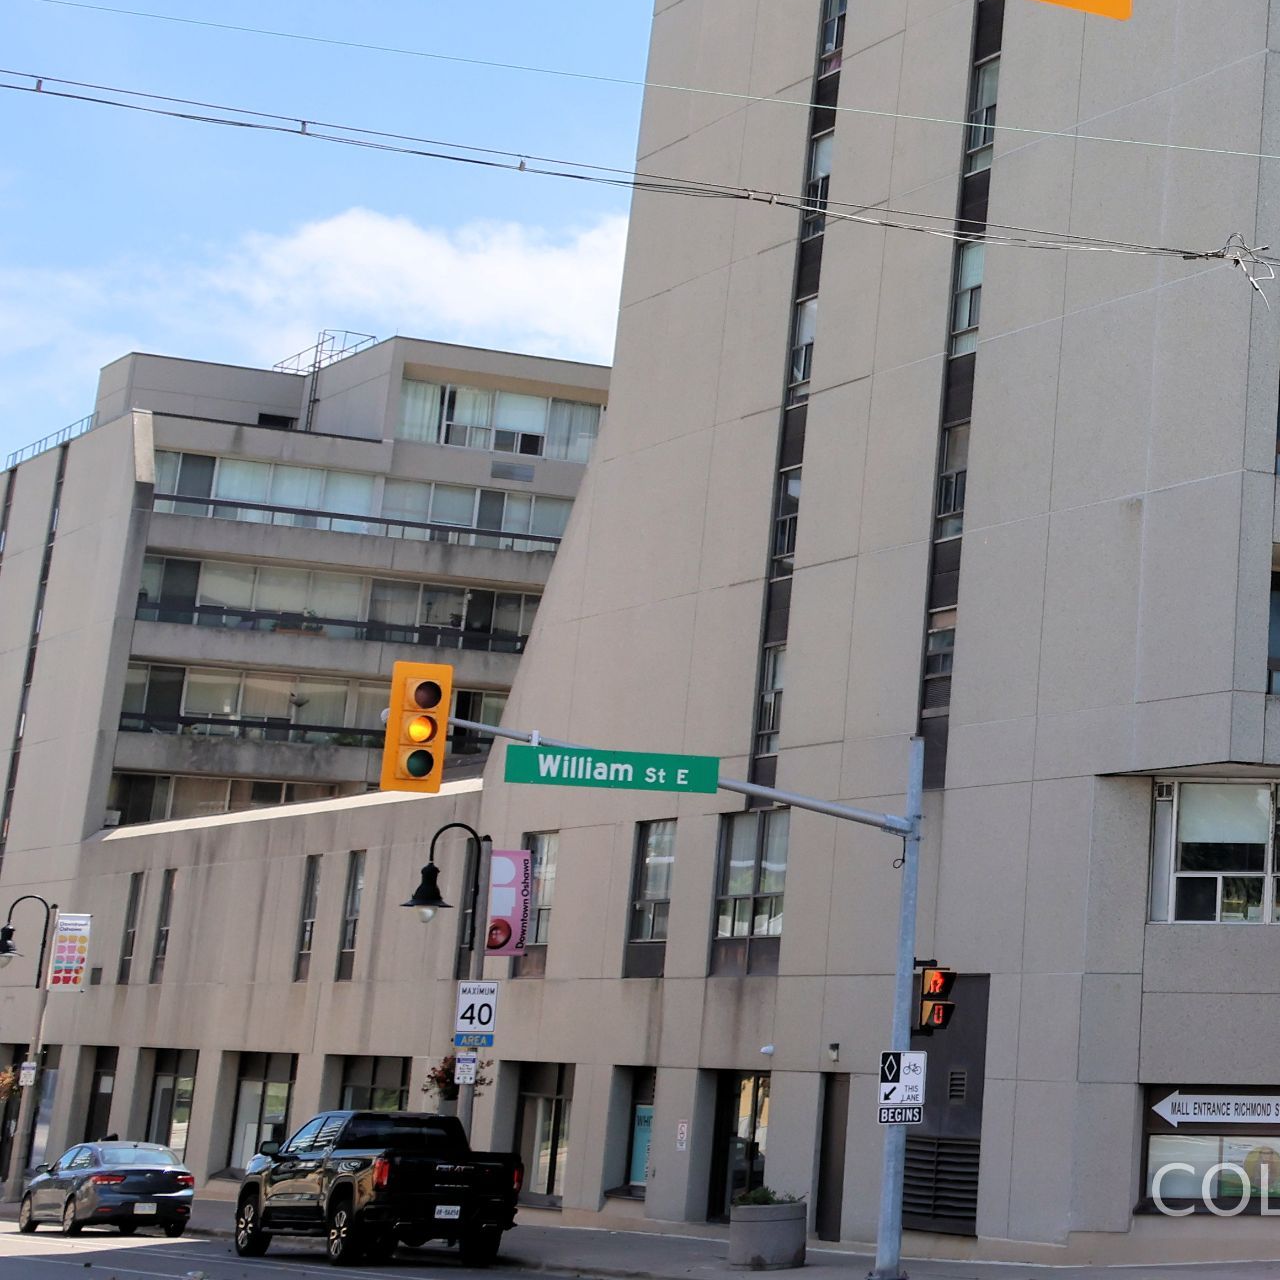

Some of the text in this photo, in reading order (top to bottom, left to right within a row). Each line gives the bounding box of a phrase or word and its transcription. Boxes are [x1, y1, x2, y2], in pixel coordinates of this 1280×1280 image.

[538, 754, 688, 785] William St E
[515, 858, 530, 949] Downtown Oshawa
[462, 987, 495, 995] MAXIMUM
[460, 1003, 492, 1025] 40
[461, 1035, 487, 1046] AREA
[904, 1085, 919, 1093] THIS
[901, 1094, 920, 1102] LANE
[881, 1108, 920, 1122] BEGINS
[1171, 1102, 1190, 1116] MALL
[1193, 1102, 1231, 1116] ENTRANCE
[1234, 1103, 1272, 1117] RICHMOND
